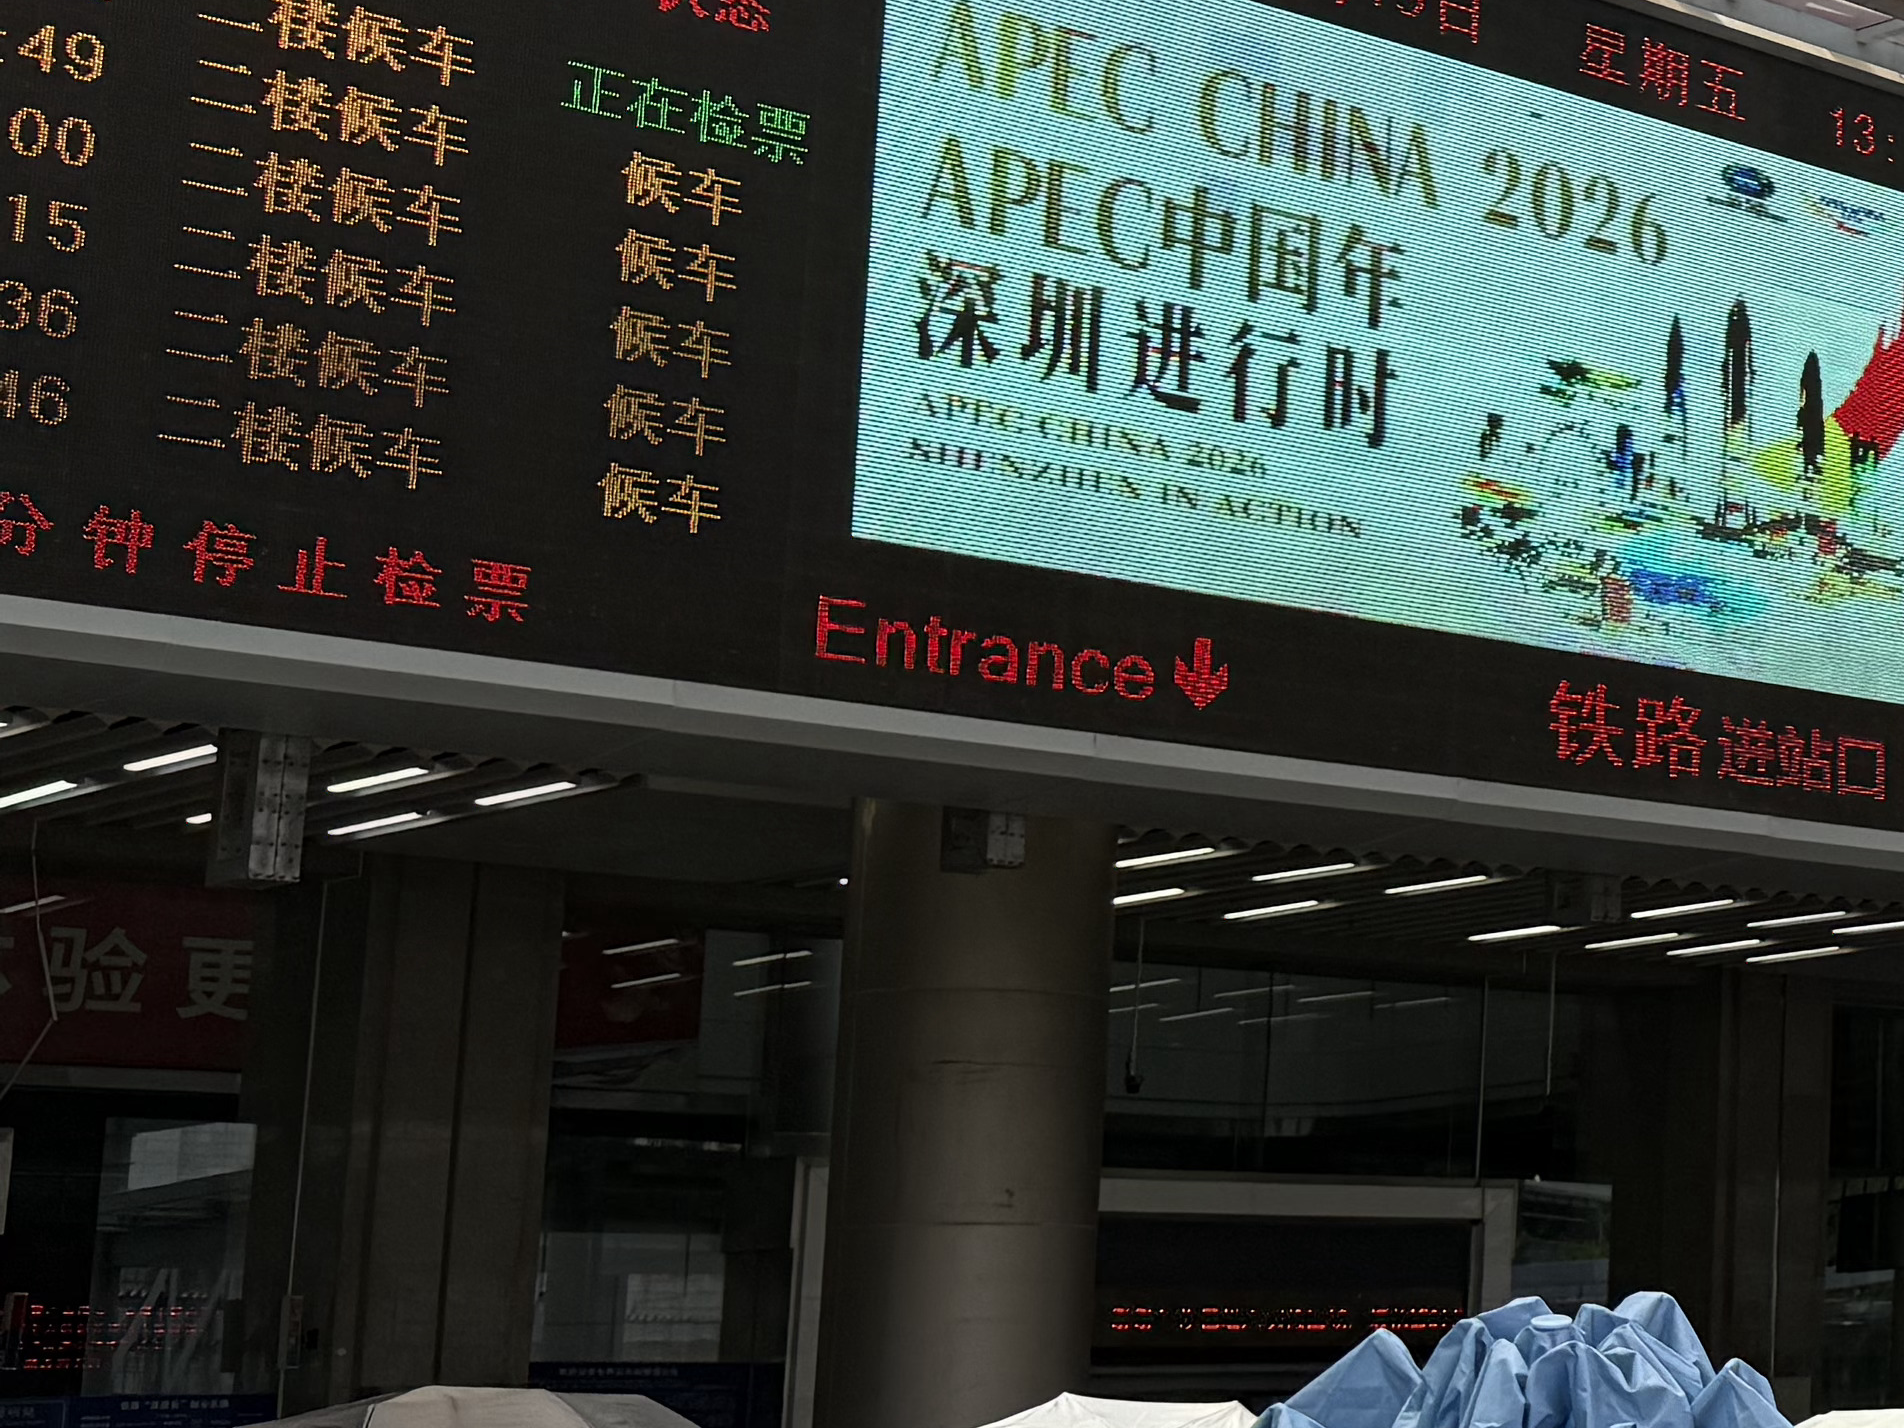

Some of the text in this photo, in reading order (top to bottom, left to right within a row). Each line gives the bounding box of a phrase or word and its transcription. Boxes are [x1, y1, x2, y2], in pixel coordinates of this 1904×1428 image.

[191, 58, 470, 167] 二楼候车
[621, 150, 744, 226] 候车
[560, 60, 811, 165] 正在检票
[1579, 23, 1747, 122] 星期五
[7, 105, 739, 303] 00 二楼候车 候车
[921, 135, 1406, 330] APEC中国年
[1199, 68, 1440, 209] CHINA
[1482, 147, 1669, 266] 2026
[7, 194, 734, 380] 15 二楼候车 候车
[916, 249, 1400, 449] 深圳进行时
[166, 309, 450, 408] 二楼候车
[603, 383, 729, 458] 候车
[157, 393, 445, 491] 二楼候车
[597, 462, 723, 535] 候车
[813, 593, 1156, 702] Entrance
[1549, 679, 1887, 802] 铁路进站口
[0, 926, 255, 1021] 验更
